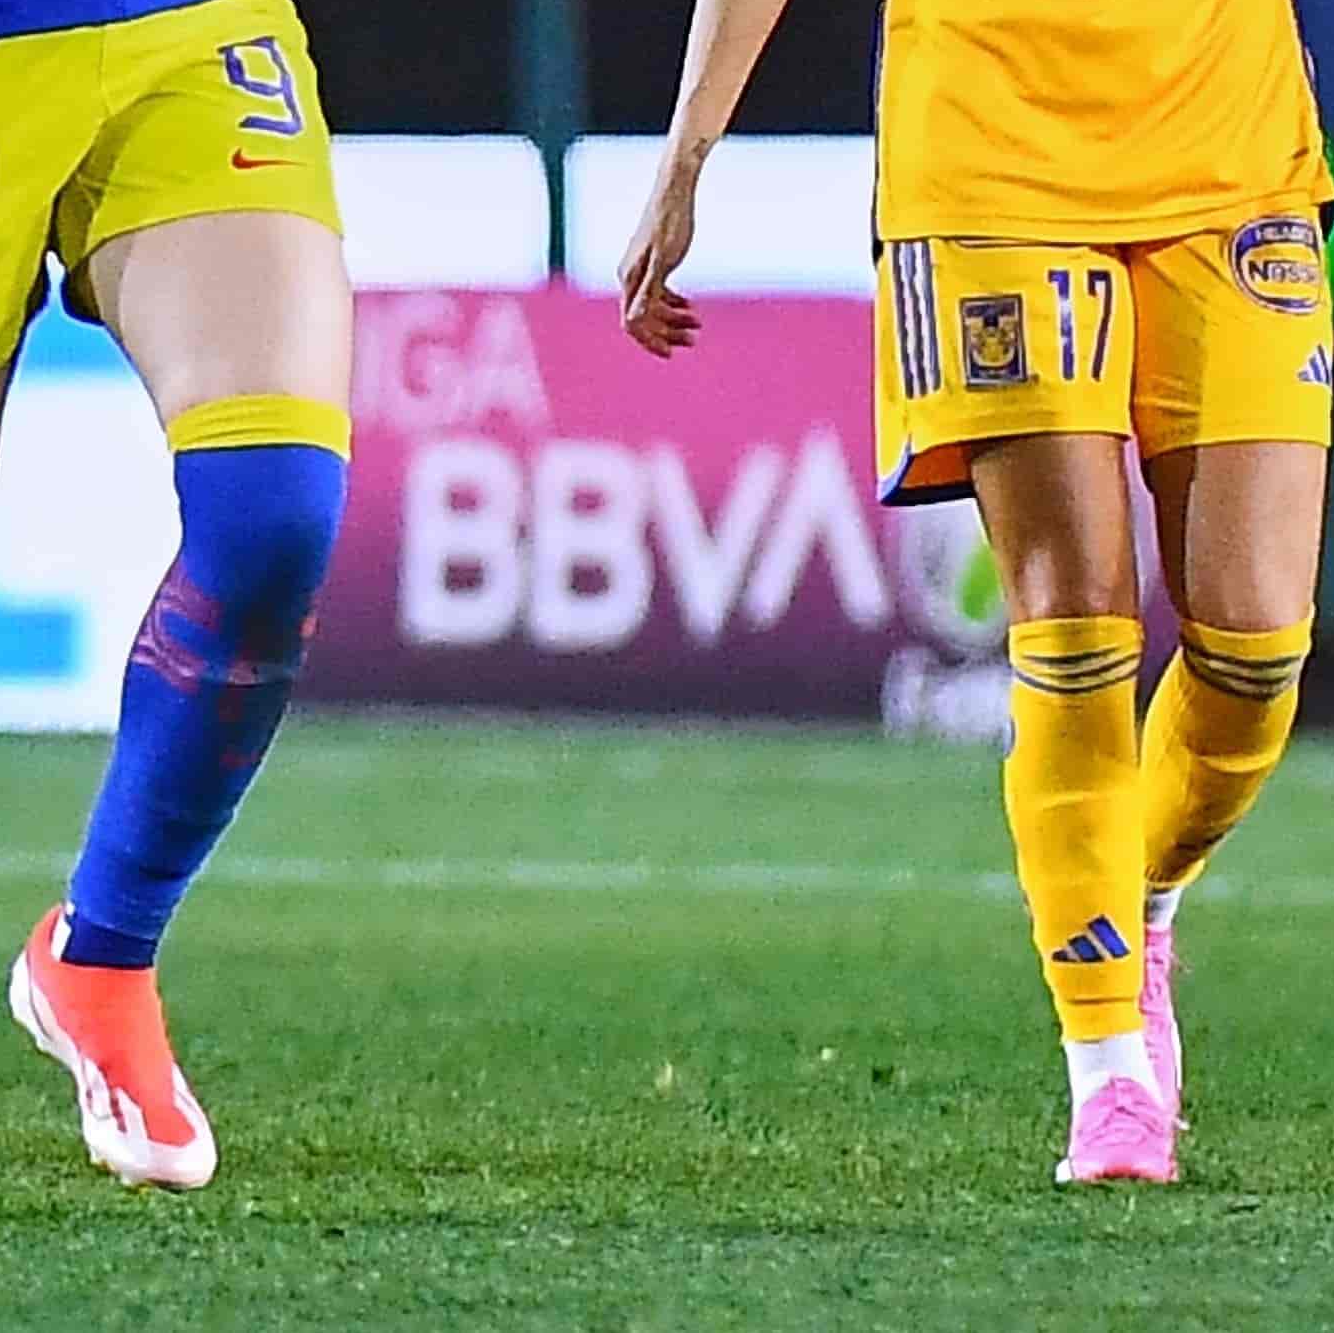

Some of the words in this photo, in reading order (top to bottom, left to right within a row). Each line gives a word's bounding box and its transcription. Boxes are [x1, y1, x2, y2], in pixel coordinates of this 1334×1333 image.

[224, 34, 304, 136] 9
[1047, 269, 1114, 383] 17
[399, 423, 893, 652] BBVA
